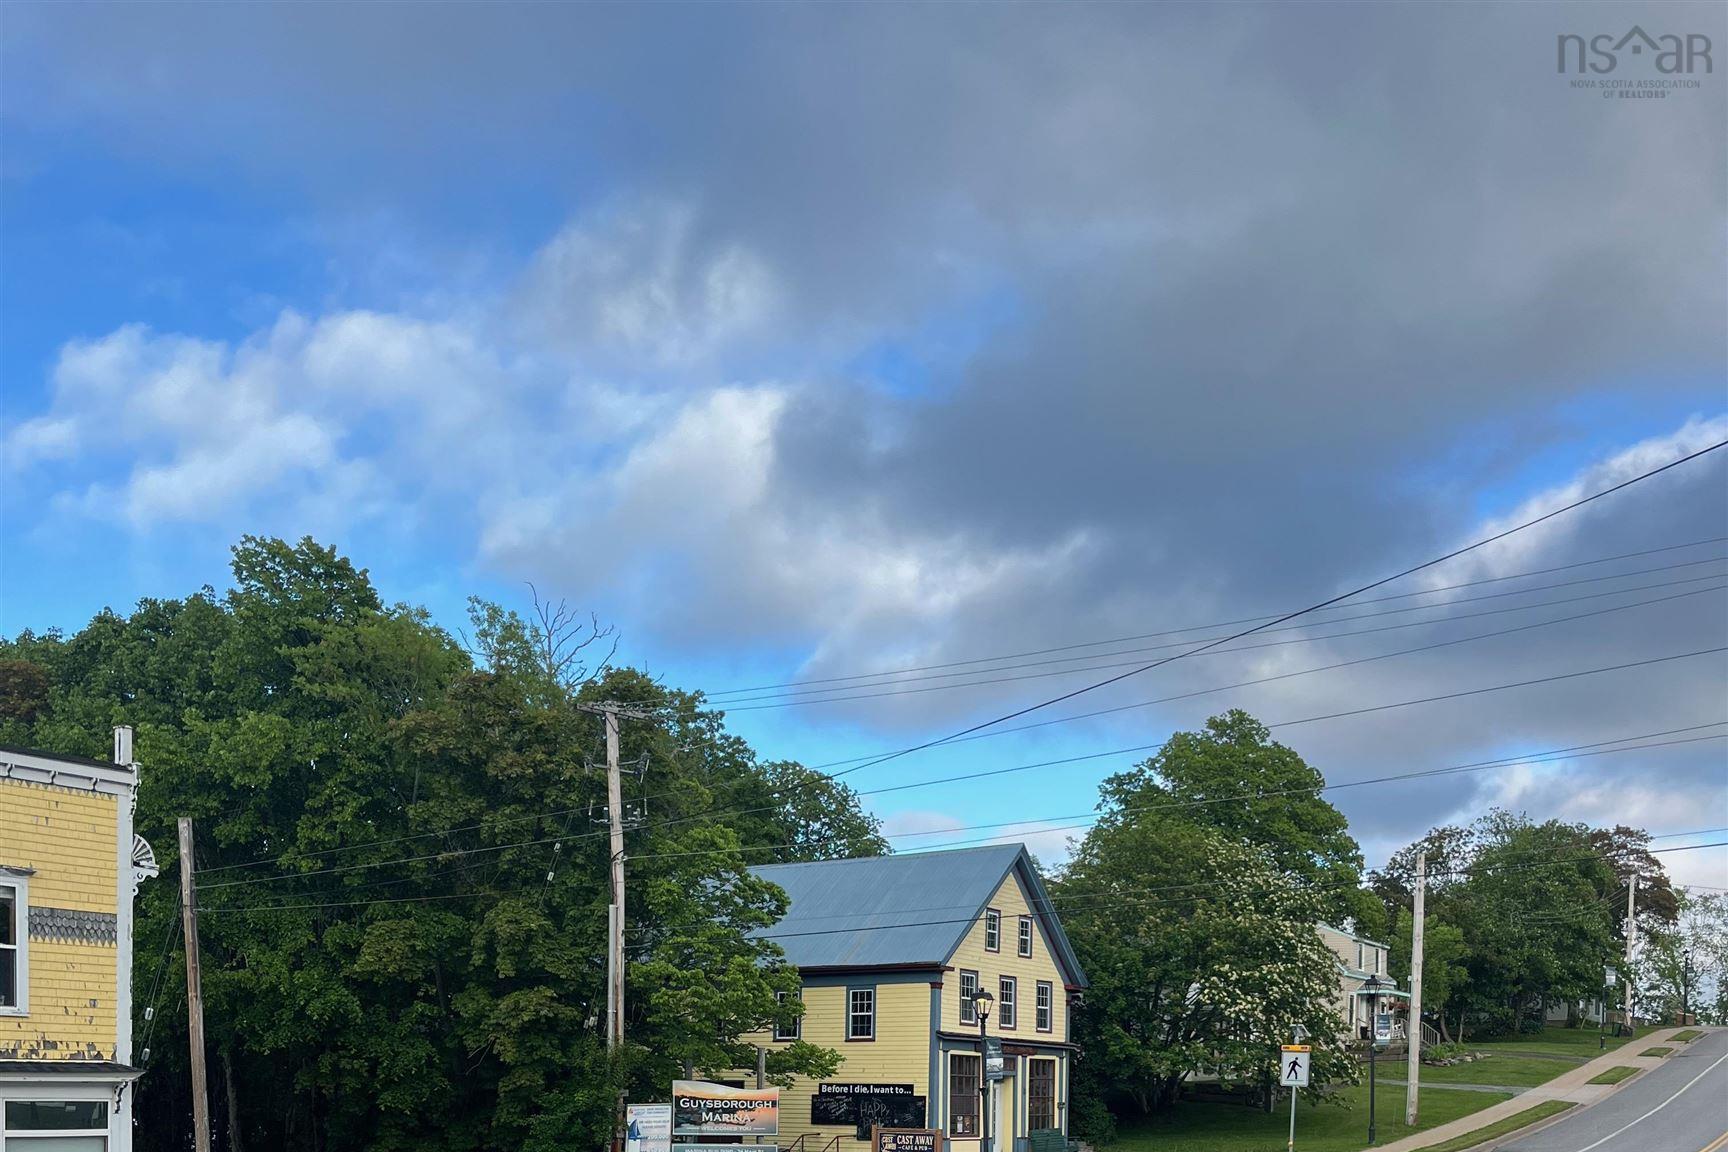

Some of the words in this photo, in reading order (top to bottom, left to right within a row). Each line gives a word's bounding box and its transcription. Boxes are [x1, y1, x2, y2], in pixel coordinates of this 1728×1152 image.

[821, 1084, 848, 1093] Before
[849, 1085, 853, 1093] I
[873, 1086, 894, 1094] want
[680, 1098, 772, 1109] GUYSBOROUGH
[701, 1112, 751, 1122] MARINA
[896, 1135, 914, 1145] CAST
[914, 1135, 934, 1145] AWAY
